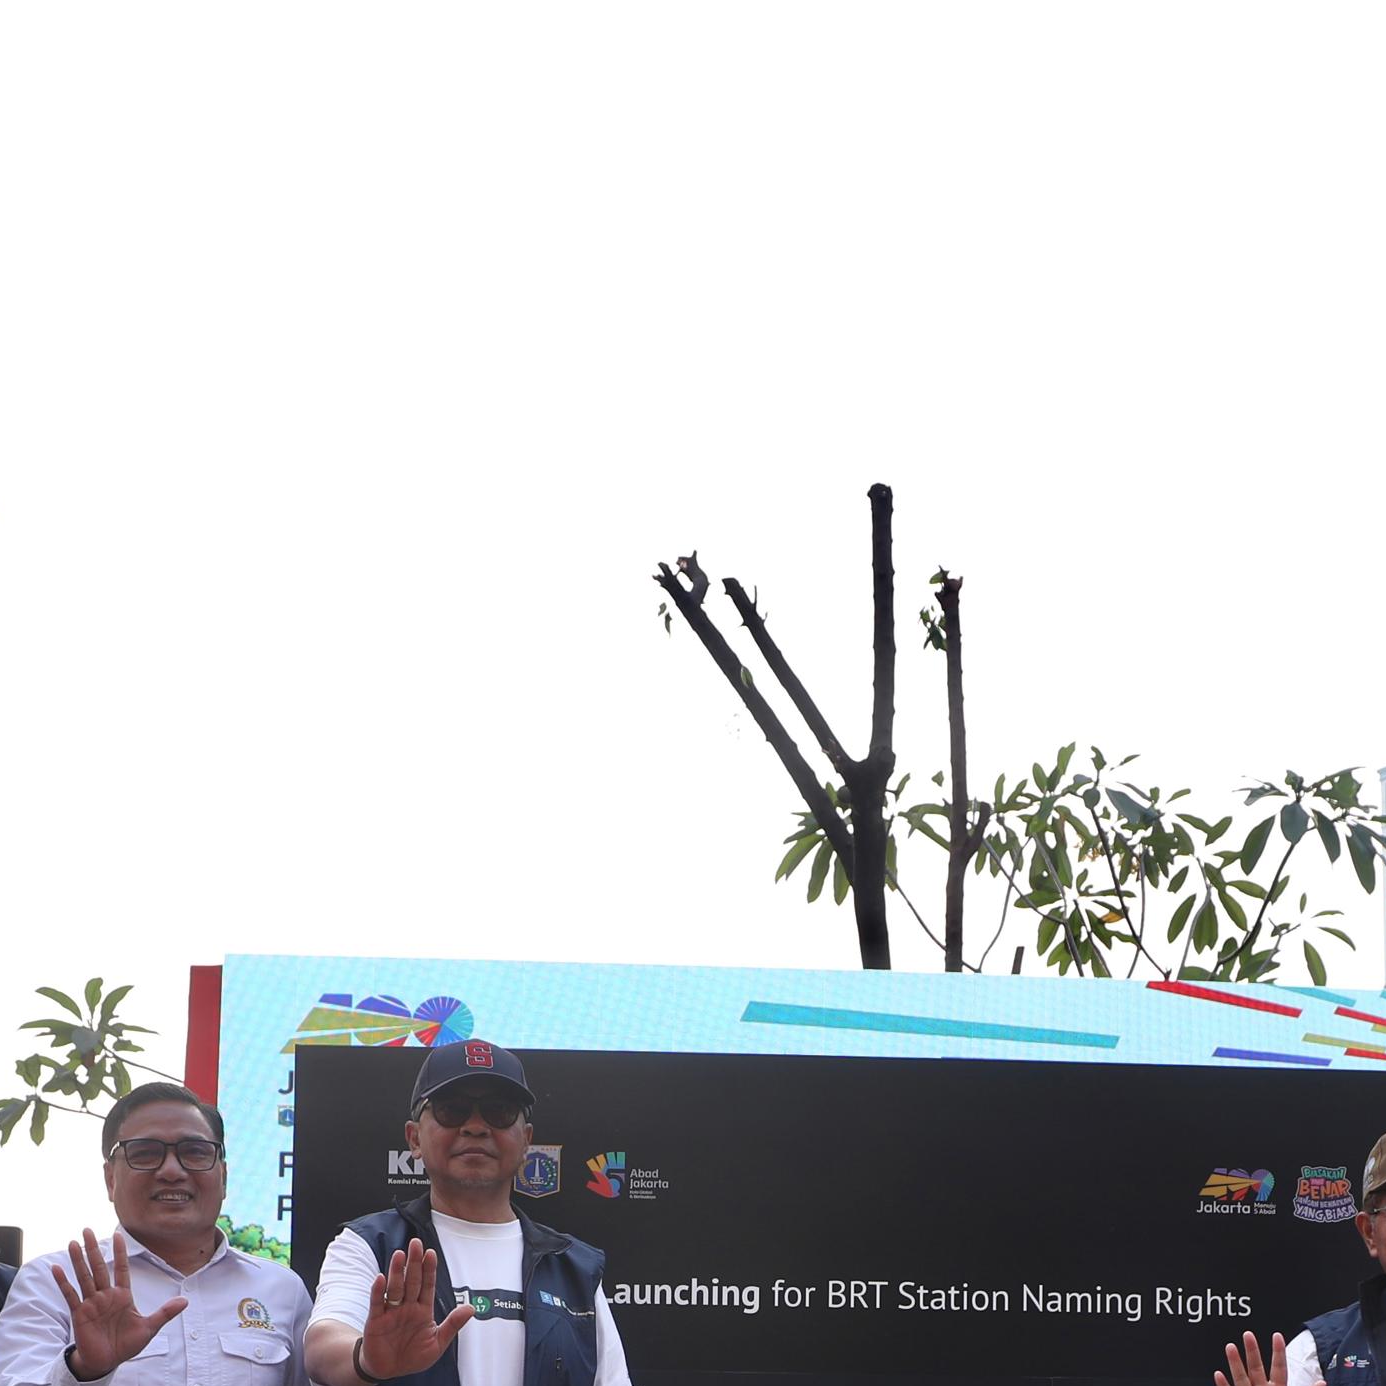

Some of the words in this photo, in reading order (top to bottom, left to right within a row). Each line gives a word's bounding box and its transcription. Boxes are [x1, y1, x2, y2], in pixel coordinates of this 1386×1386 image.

[464, 1042, 493, 1068] S
[629, 1168, 659, 1178] Abad
[1303, 1168, 1344, 1180] BIASAKAN
[629, 1178, 669, 1190] Jakarta
[1299, 1179, 1350, 1200] BENAR
[1196, 1200, 1251, 1214] Jakarta
[1296, 1203, 1324, 1220] YANG
[477, 1296, 483, 1304] 6
[606, 1278, 761, 1314] aunching
[771, 1279, 816, 1308] for
[828, 1280, 889, 1309] BRT
[898, 1281, 1010, 1312] Station
[1022, 1284, 1143, 1322] Naming
[1155, 1286, 1253, 1323] Rights
[475, 1304, 486, 1312] 17
